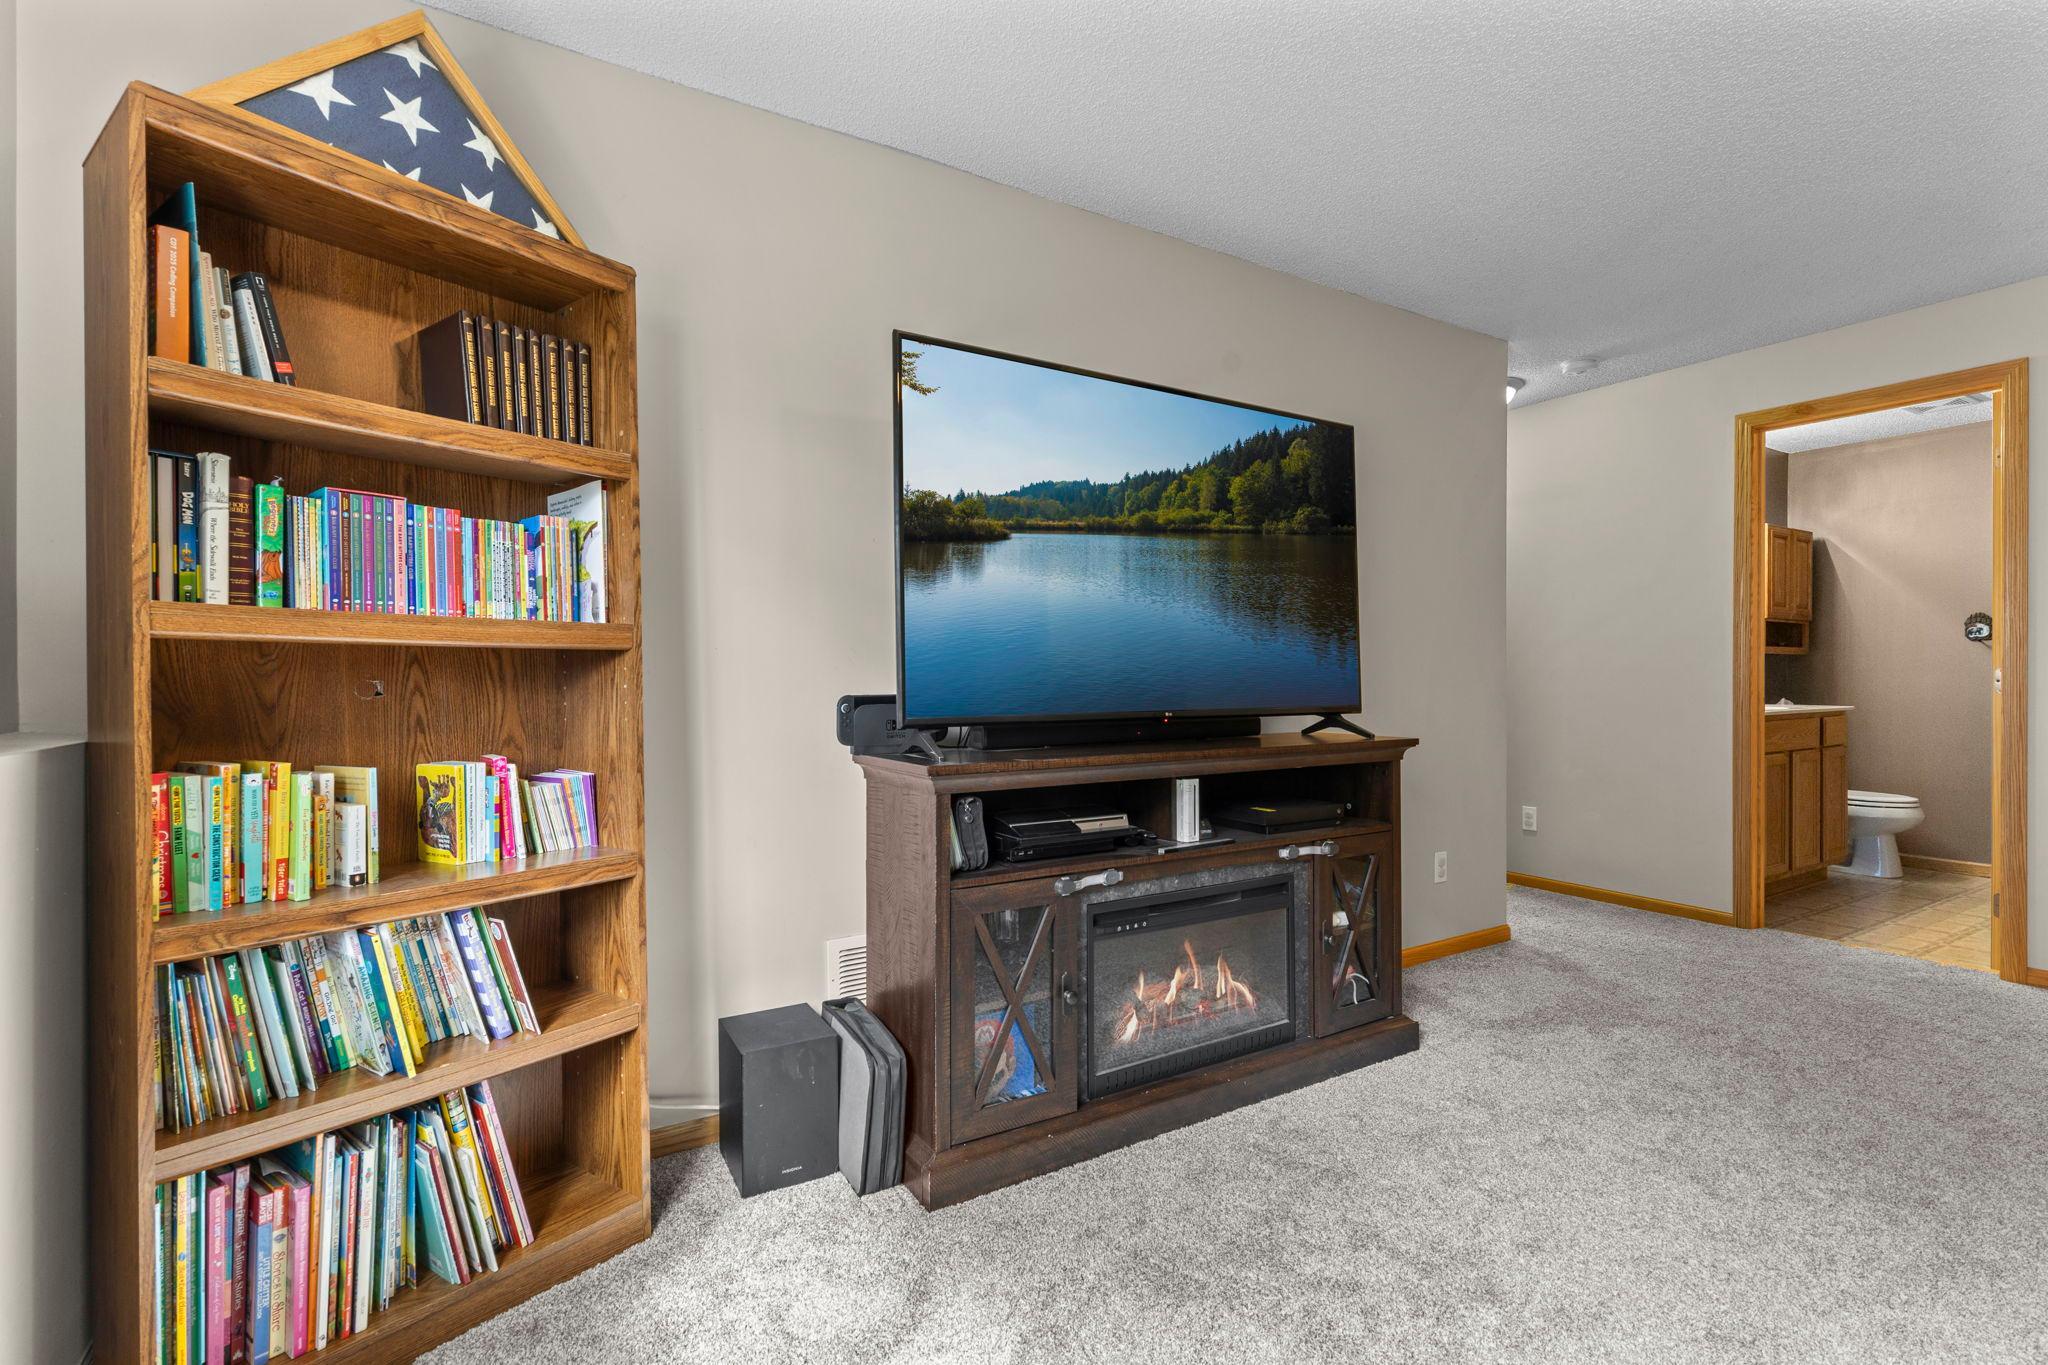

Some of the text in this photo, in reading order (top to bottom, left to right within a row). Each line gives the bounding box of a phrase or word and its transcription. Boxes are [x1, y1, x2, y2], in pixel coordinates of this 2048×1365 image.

[167, 265, 177, 285] Coding
[181, 491, 194, 525] DOG MAN
[173, 826, 183, 855] FARM FLEET
[211, 824, 221, 881] THE CONSTRUCTION CREW
[158, 830, 171, 889] Christmas
[276, 862, 286, 894] tiger tales
[292, 972, 303, 987] Pete
[296, 989, 306, 1002] Cat
[356, 965, 382, 1033] AMAZING SCIENCE
[233, 1280, 244, 1311] Stories
[260, 1255, 272, 1308] LITTLE CRITTER
[270, 1250, 286, 1332] Stories to Share
